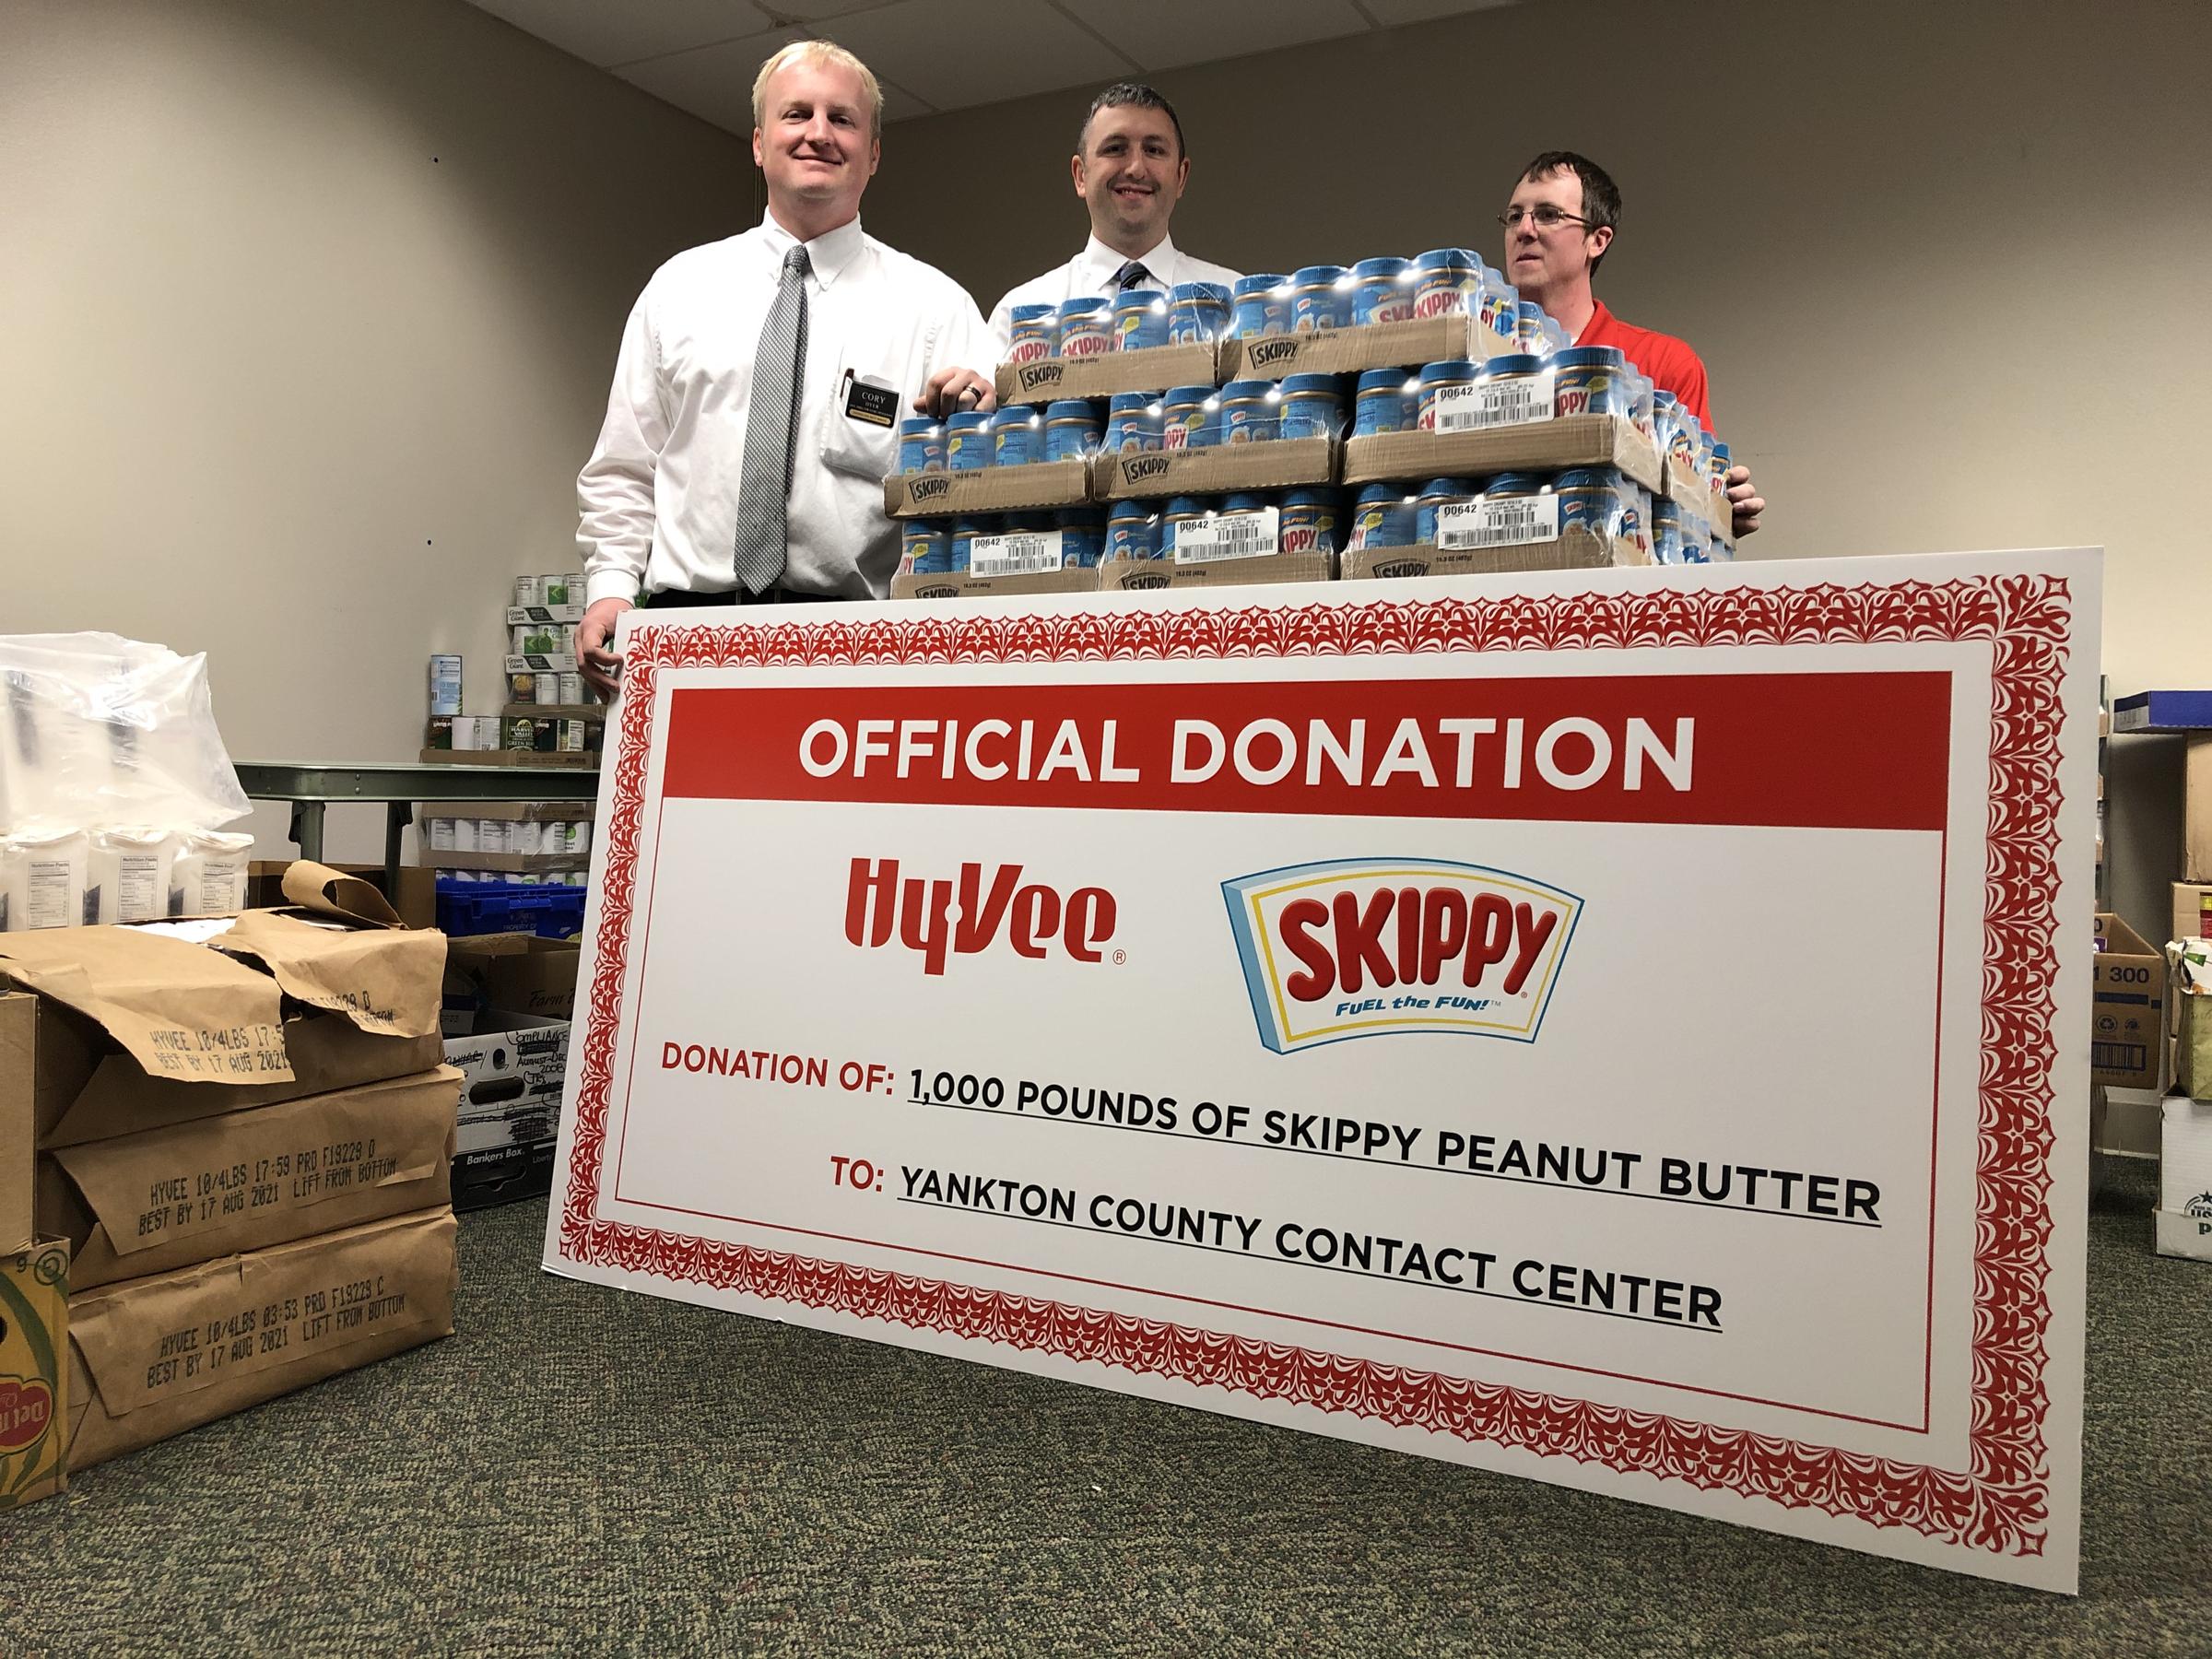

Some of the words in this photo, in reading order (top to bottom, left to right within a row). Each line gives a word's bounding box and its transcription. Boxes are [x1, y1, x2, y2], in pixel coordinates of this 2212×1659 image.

[1416, 291, 1460, 319] KIPPY
[1011, 342, 1050, 365] KIPPY
[1256, 342, 1298, 364] SKIPPY
[1026, 366, 1063, 387] SKIPPY
[862, 392, 886, 404] CORY
[1441, 386, 1474, 401] 00642
[1130, 458, 1170, 480] SKIPPY
[916, 479, 949, 500] SKIPPY
[1443, 504, 1477, 516] 00642
[1180, 520, 1208, 533] 00642
[974, 538, 1000, 549] 00642
[799, 718, 1140, 783] OFFICIAL
[1171, 716, 1695, 792] DONATION
[845, 857, 1117, 975] HyVee
[1279, 887, 1558, 1002] SKIPPY
[2110, 967, 2150, 983] 300
[1392, 995, 1431, 1009] the
[1434, 996, 1490, 1011] FUN!
[150, 1030, 192, 1053] HYVEE
[196, 1027, 250, 1052] 10/4LBS
[156, 1052, 184, 1071] BEST
[187, 1053, 201, 1072] BY
[206, 1054, 222, 1074] 17
[229, 1052, 253, 1074] AUG
[257, 1050, 288, 1071] 2021
[539, 1064, 566, 1074] 2008
[661, 1041, 829, 1088] DONATION
[839, 1061, 895, 1096] OF:
[910, 1068, 1006, 1108] 1,000
[1017, 1080, 1178, 1130] POUNDS
[1192, 1101, 1250, 1138] OF
[1263, 1110, 1422, 1161] SKIPPY
[1437, 1131, 1641, 1190] PEANUT
[1660, 1157, 1881, 1222] BUTTER
[466, 1150, 504, 1166] Bankers
[505, 1147, 523, 1159] Box
[150, 1177, 189, 1207] HYVEE
[195, 1164, 247, 1197] 10/4LBS
[254, 1156, 290, 1183] 17:59
[138, 1210, 171, 1237] BEST
[177, 1204, 194, 1226] BY
[200, 1199, 216, 1221] 17
[222, 1191, 245, 1215] AUG
[251, 1184, 280, 1208] 2021
[293, 1175, 321, 1198] LIFT
[325, 1169, 353, 1191] FROM
[358, 1158, 398, 1183] BOTTOM
[830, 1155, 885, 1193] TO:
[900, 1165, 1077, 1222] YANKTON
[1088, 1194, 1263, 1251] COUNTY
[1275, 1222, 1496, 1289] CONTACT
[1512, 1259, 1724, 1327] CENTER
[159, 1328, 198, 1359] HYVEE
[206, 1310, 256, 1346] 10/4LBS
[263, 1300, 299, 1328] 03:53
[147, 1361, 179, 1389] BEST
[185, 1353, 202, 1378] BY
[209, 1347, 224, 1371] 17
[230, 1339, 253, 1363] AUG
[259, 1327, 289, 1355] 2021
[302, 1313, 332, 1342] LIFT
[336, 1306, 362, 1332] FROM
[368, 1293, 406, 1322] BOTTOM
